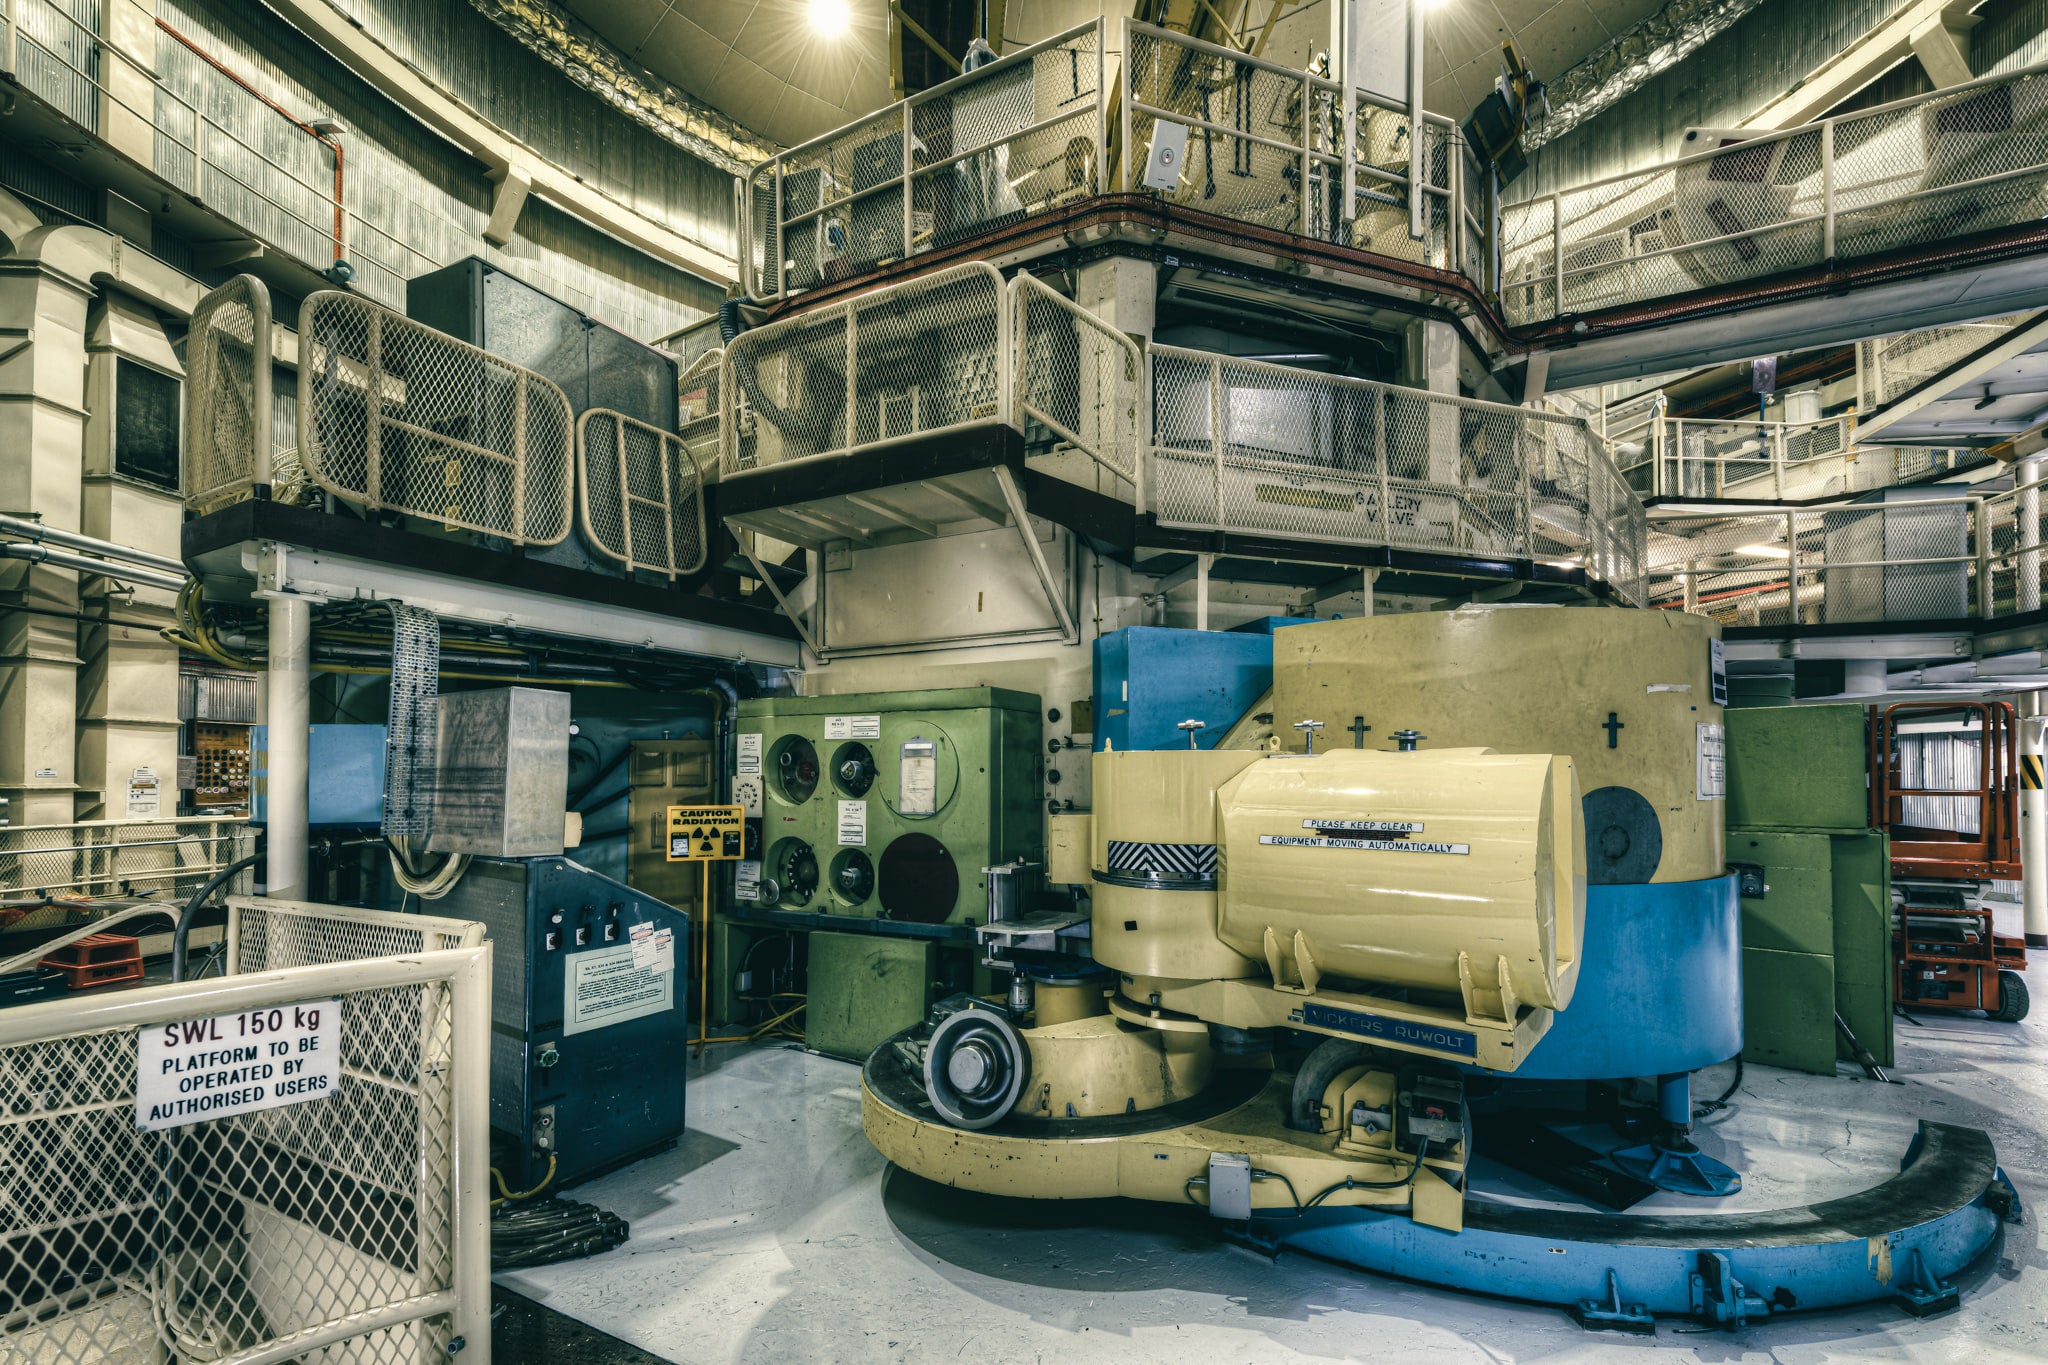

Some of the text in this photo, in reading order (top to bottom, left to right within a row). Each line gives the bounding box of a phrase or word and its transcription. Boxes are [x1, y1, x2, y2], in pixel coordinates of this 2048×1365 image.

[1311, 820, 1413, 831] PLEASE KEEP CLEAR
[1271, 836, 1453, 853] EQUIPMENT MOVING AUTOMATICALLY
[164, 1006, 320, 1047] SWL 150 kg
[1395, 1026, 1465, 1048] RUWOLT
[162, 1035, 320, 1075] PLATFORM TO BE
[179, 1058, 304, 1093] OPERATED BY
[149, 1075, 327, 1121] AUTHORISED USERS
